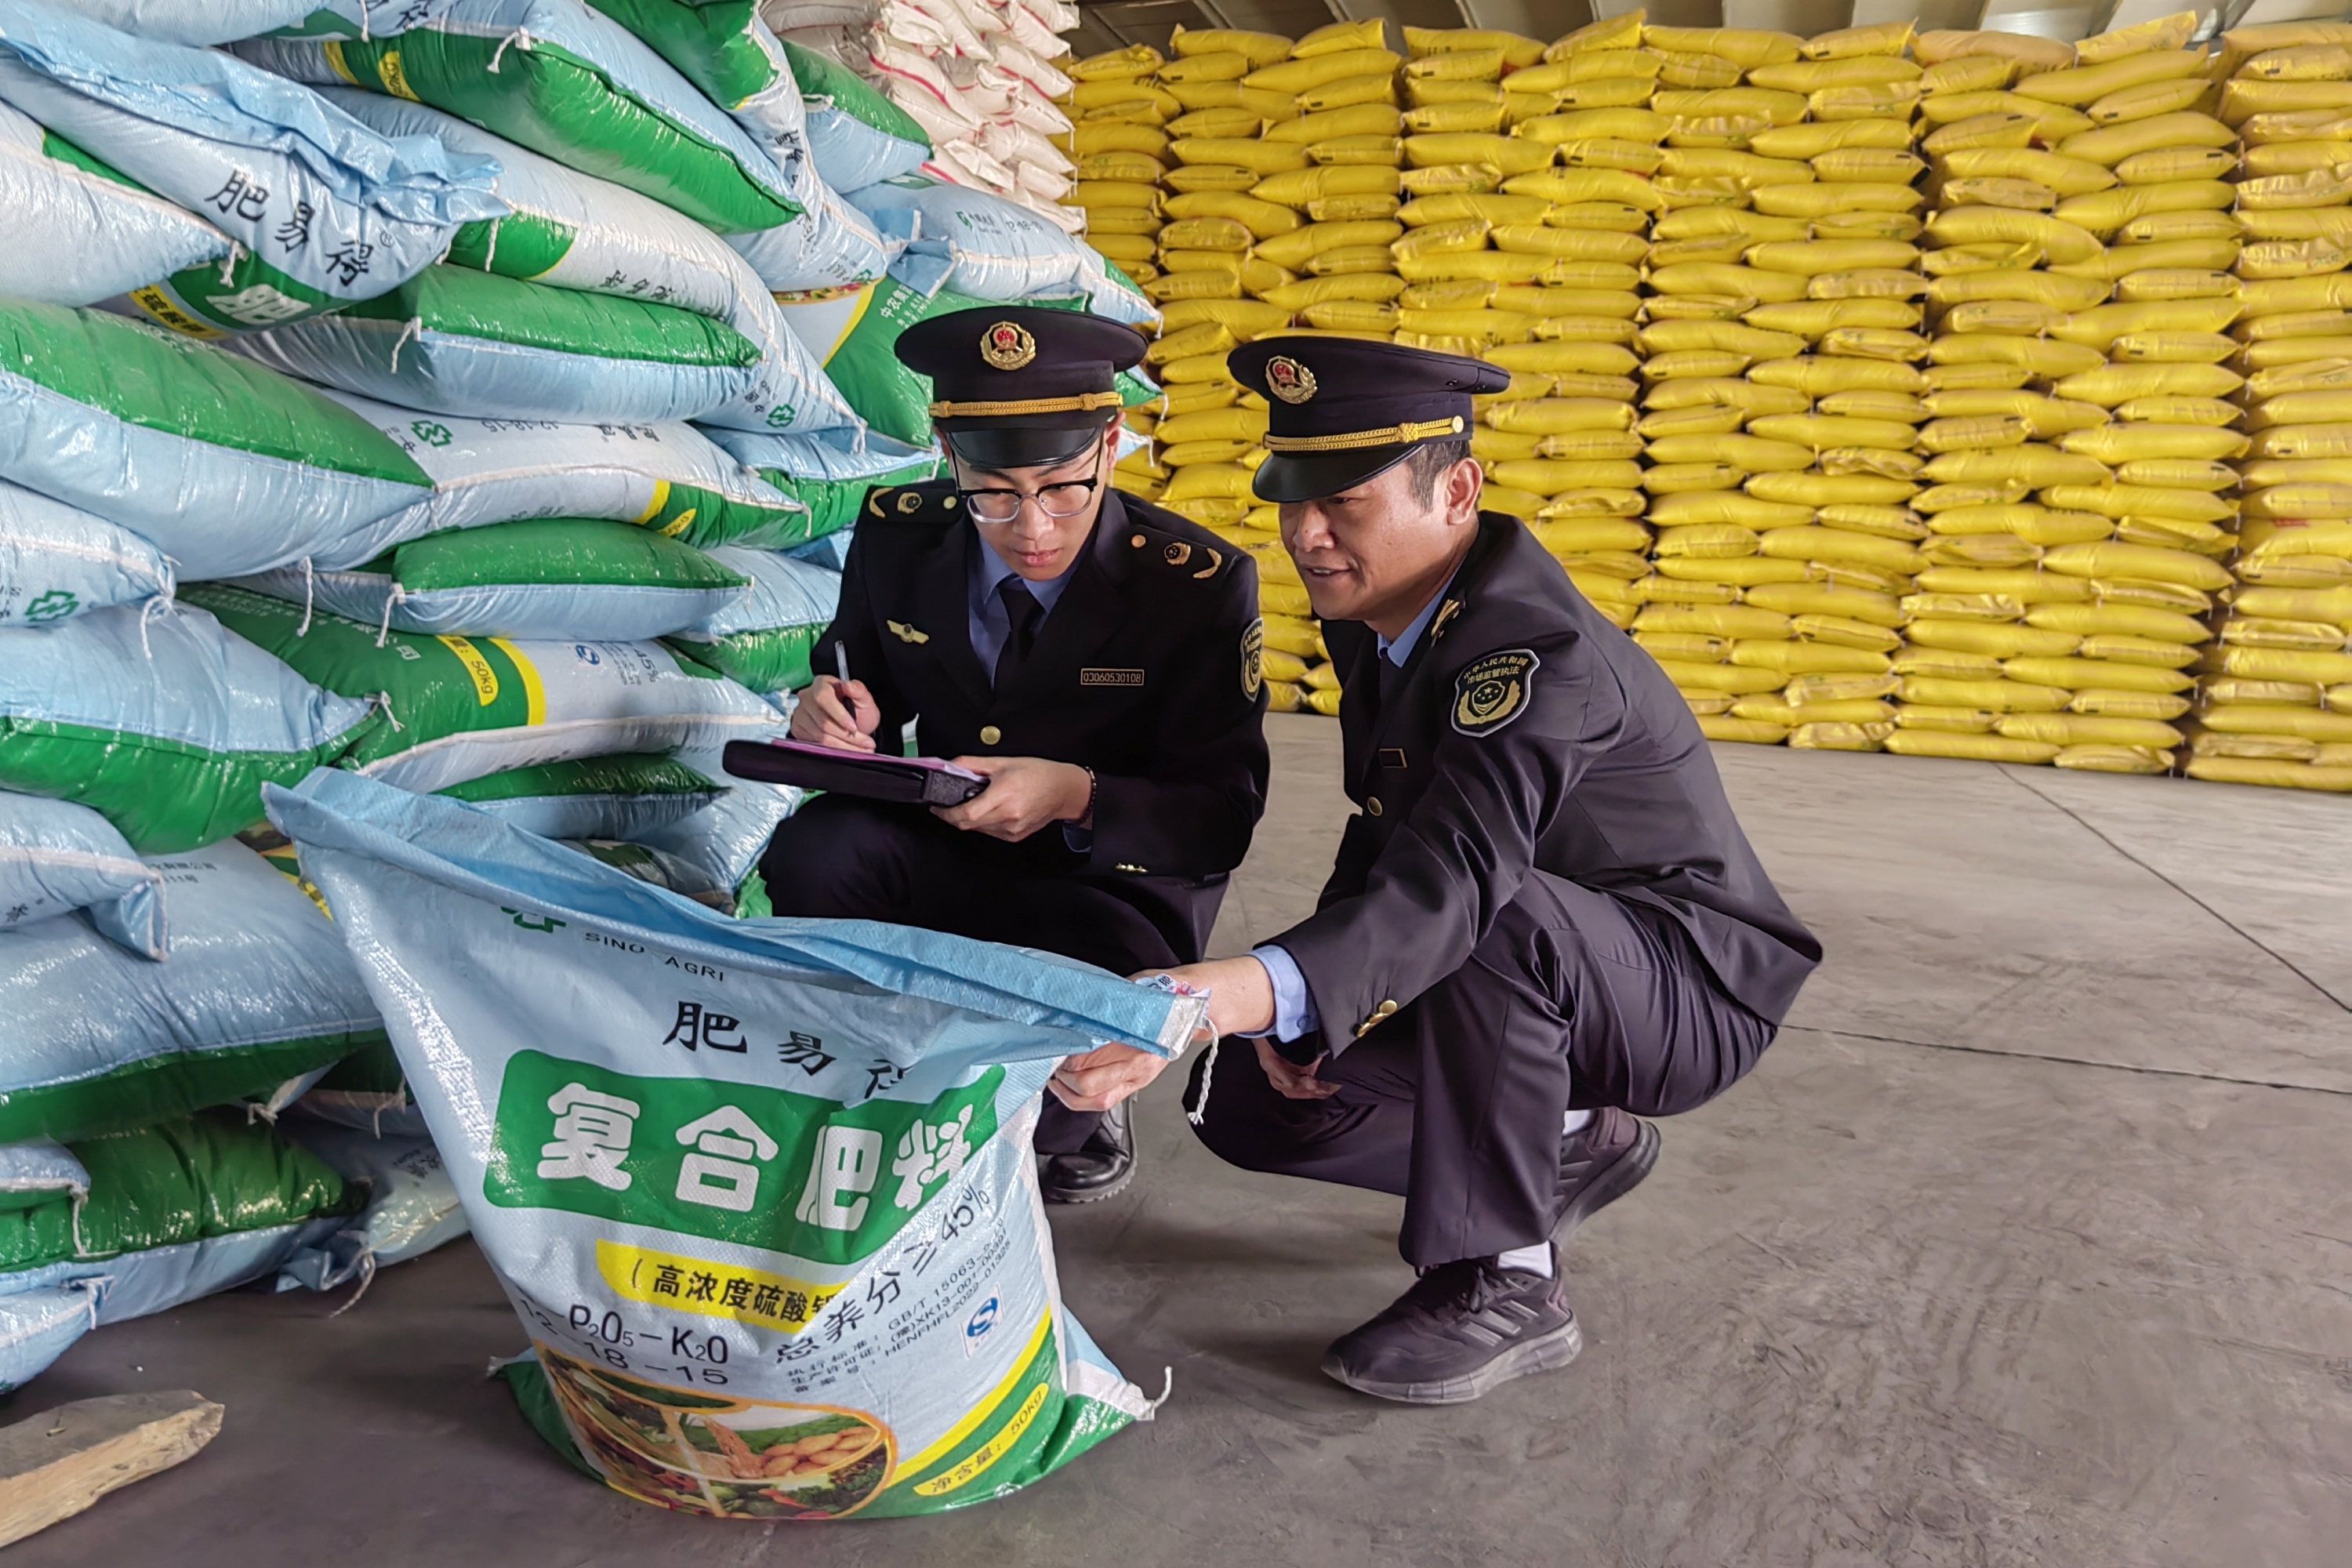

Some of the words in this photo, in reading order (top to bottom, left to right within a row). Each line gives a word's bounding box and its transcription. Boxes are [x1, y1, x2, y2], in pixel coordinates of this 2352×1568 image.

[205, 169, 376, 287] 肥易得
[470, 659, 495, 695] 50kg
[1083, 672, 1142, 683] 03060530108
[1463, 655, 1529, 680] 中华人民共和国
[585, 932, 645, 953] SINO
[665, 956, 724, 982] AGRI
[537, 1082, 974, 1232] 复合肥料
[887, 1298, 927, 1330] GB/T
[931, 1443, 1002, 1493] 净含量:
[1011, 1389, 1042, 1435] 50kg
